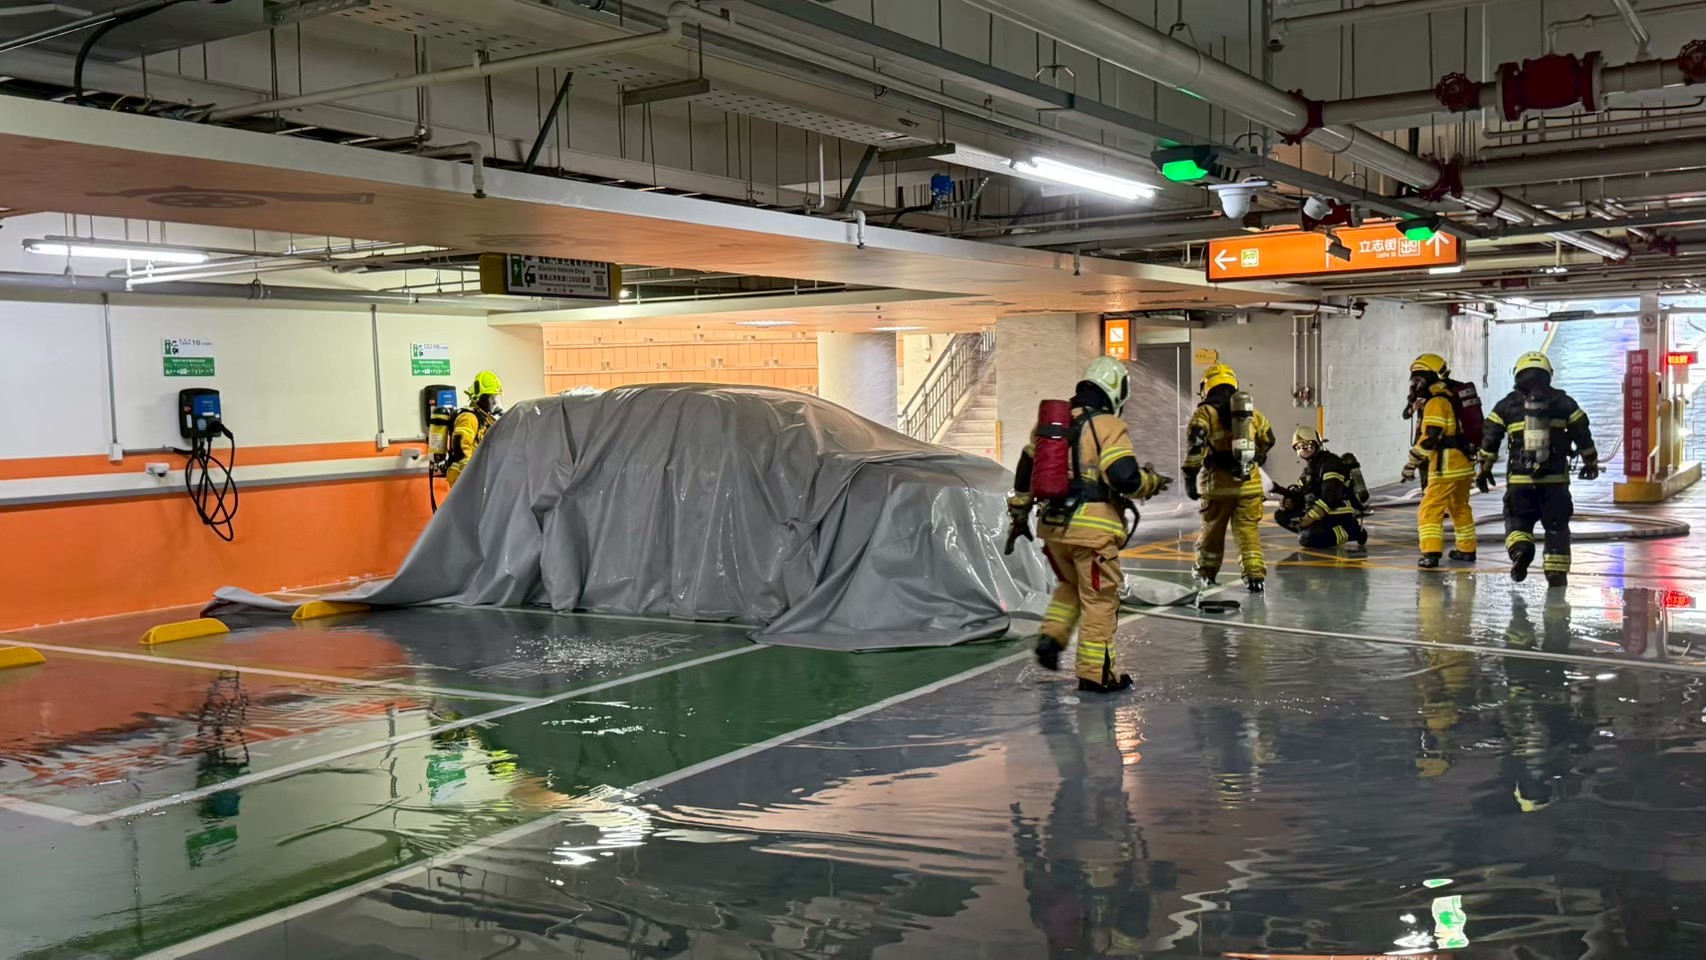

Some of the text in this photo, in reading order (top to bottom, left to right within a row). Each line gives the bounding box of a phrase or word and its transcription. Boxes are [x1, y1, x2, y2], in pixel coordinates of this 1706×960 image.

[1359, 238, 1397, 253] 立志街
[575, 267, 585, 275] Only
